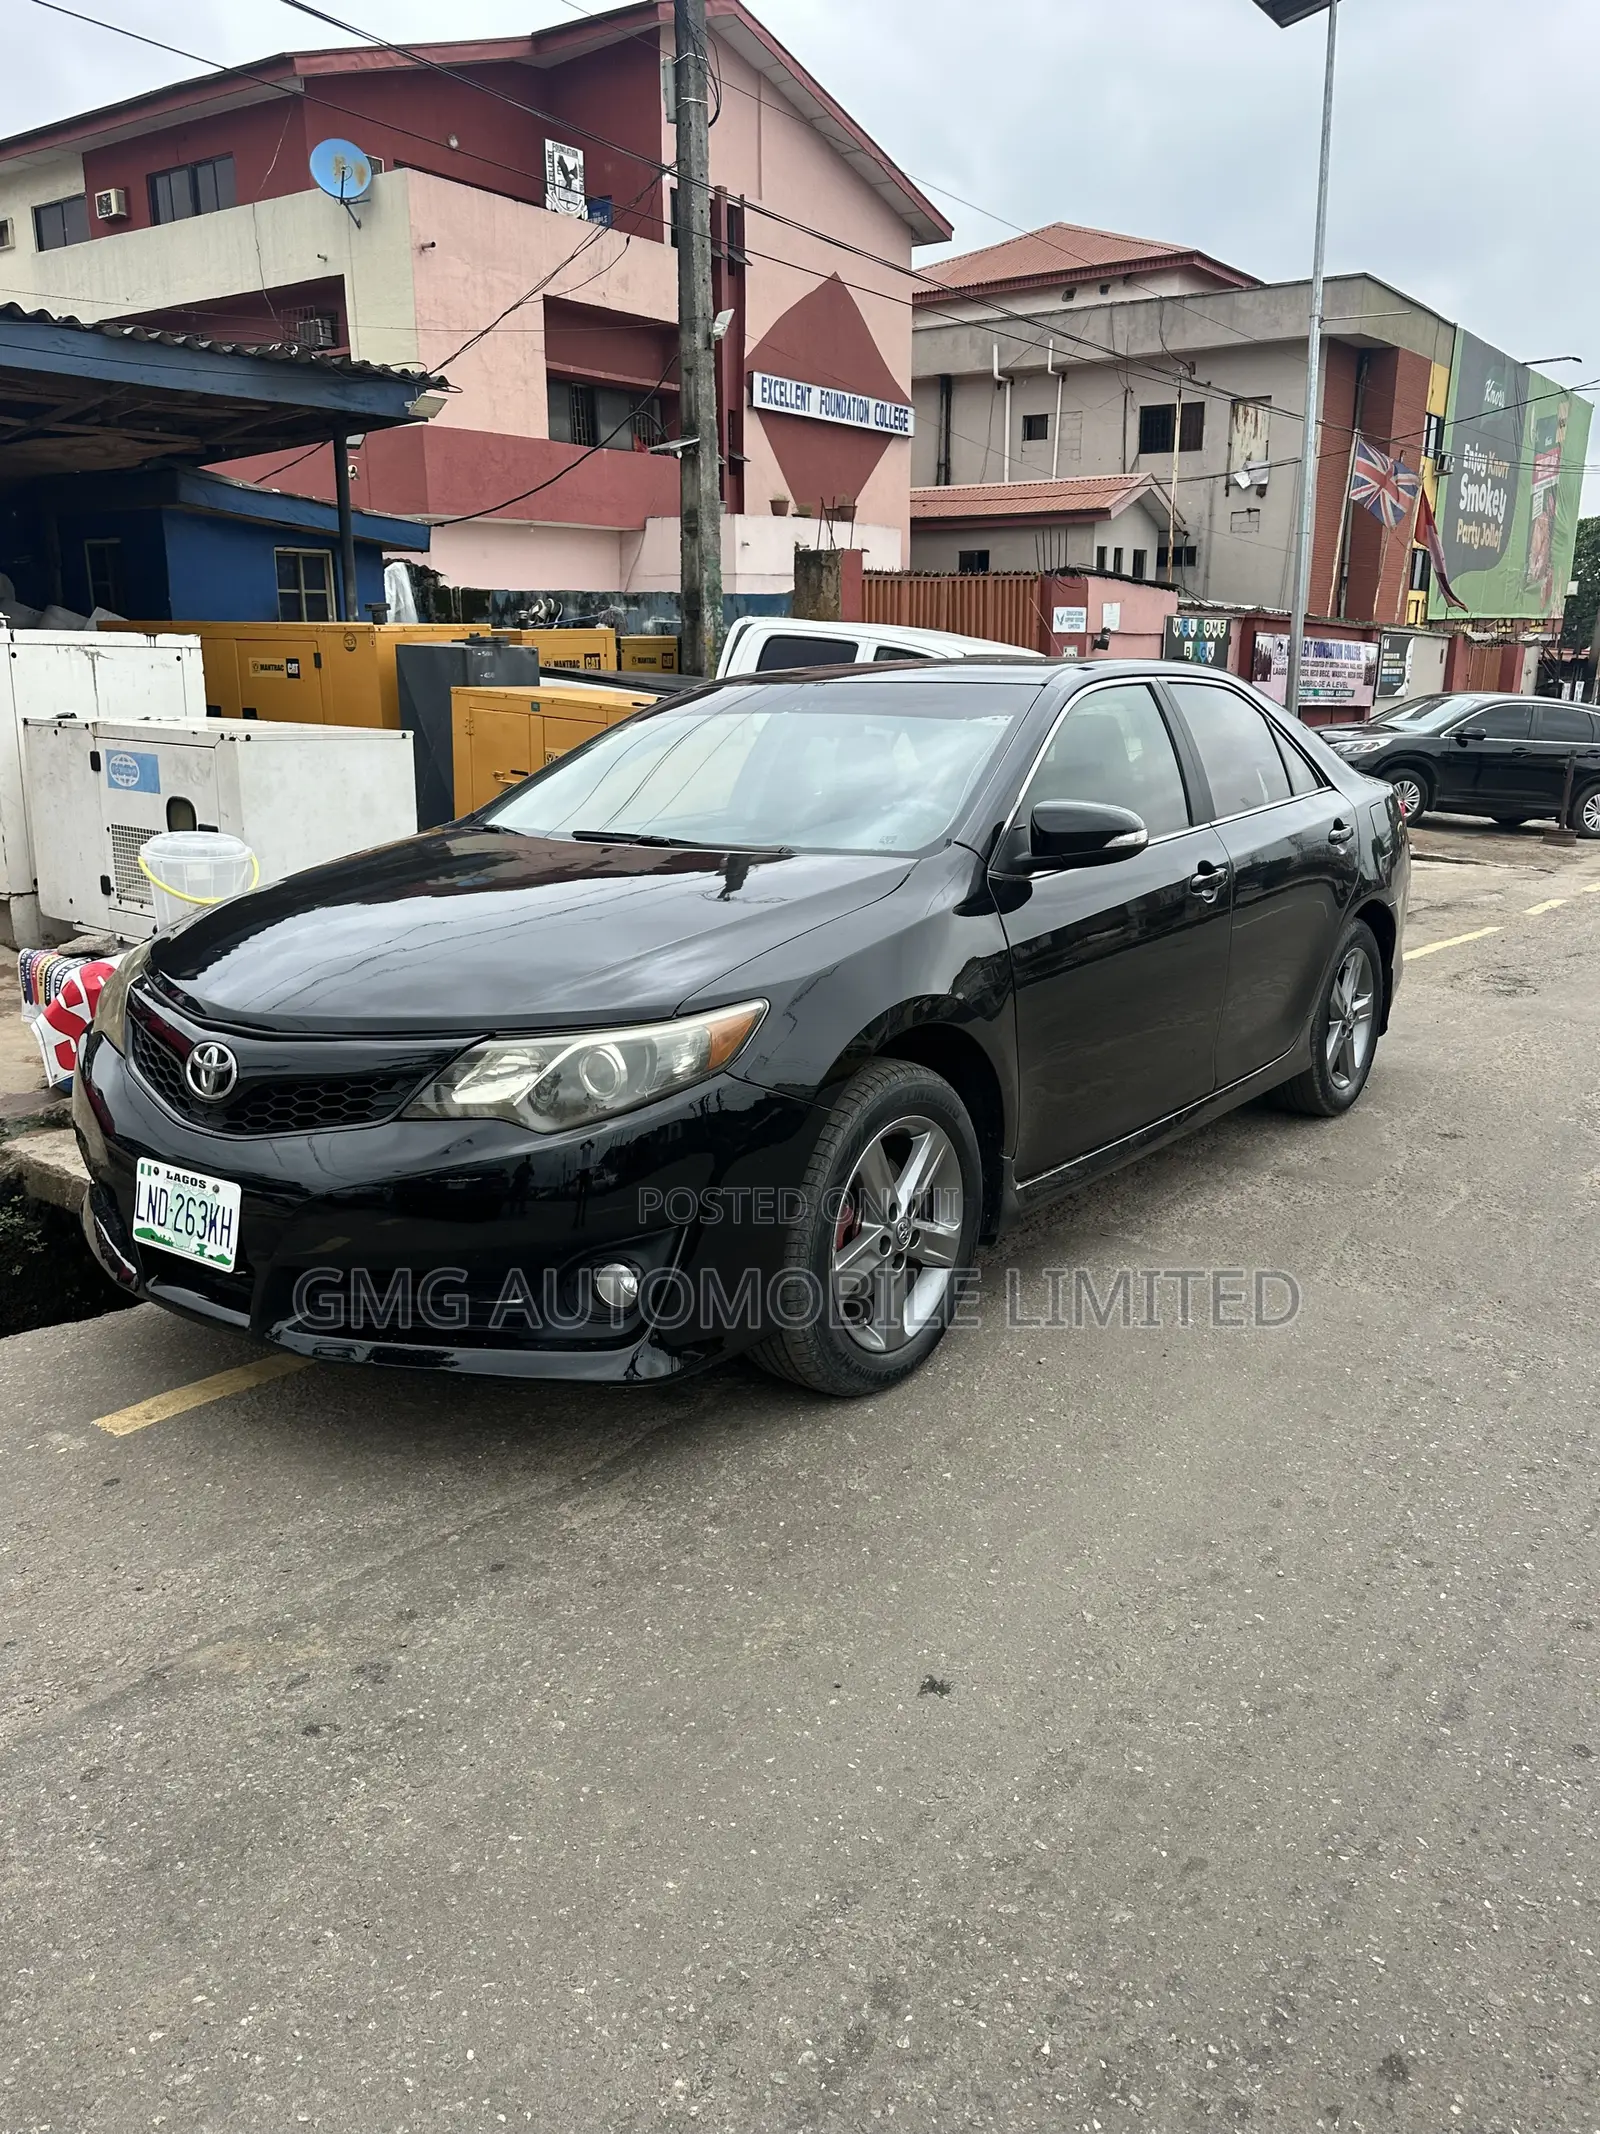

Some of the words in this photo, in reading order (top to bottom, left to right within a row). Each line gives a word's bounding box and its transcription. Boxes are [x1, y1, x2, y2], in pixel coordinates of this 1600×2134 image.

[547, 150, 556, 191] ECELLENT
[761, 376, 812, 412] EXCELLENT
[819, 389, 869, 424] FOUNDATION
[874, 402, 909, 432] COLLEGE
[1463, 443, 1488, 478] Enjoy
[1487, 451, 1511, 480] Knorr
[1459, 472, 1507, 523] Smokey
[1456, 518, 1480, 549] Party
[1480, 520, 1503, 552] Jollof
[1173, 619, 1226, 634] WELCOME
[1185, 645, 1215, 659] BACK
[259, 663, 285, 672] MANTRAC
[287, 662, 299, 674] CAT
[553, 659, 581, 669] MANTRAC
[585, 655, 600, 669] CAT
[637, 656, 657, 665] MANTRAC
[1273, 667, 1287, 676] LAGOS
[1299, 680, 1326, 688] AMBRIDGE
[1326, 680, 1331, 688] A
[1332, 681, 1349, 689] LEVEL
[166, 1170, 207, 1189] LAGOS
